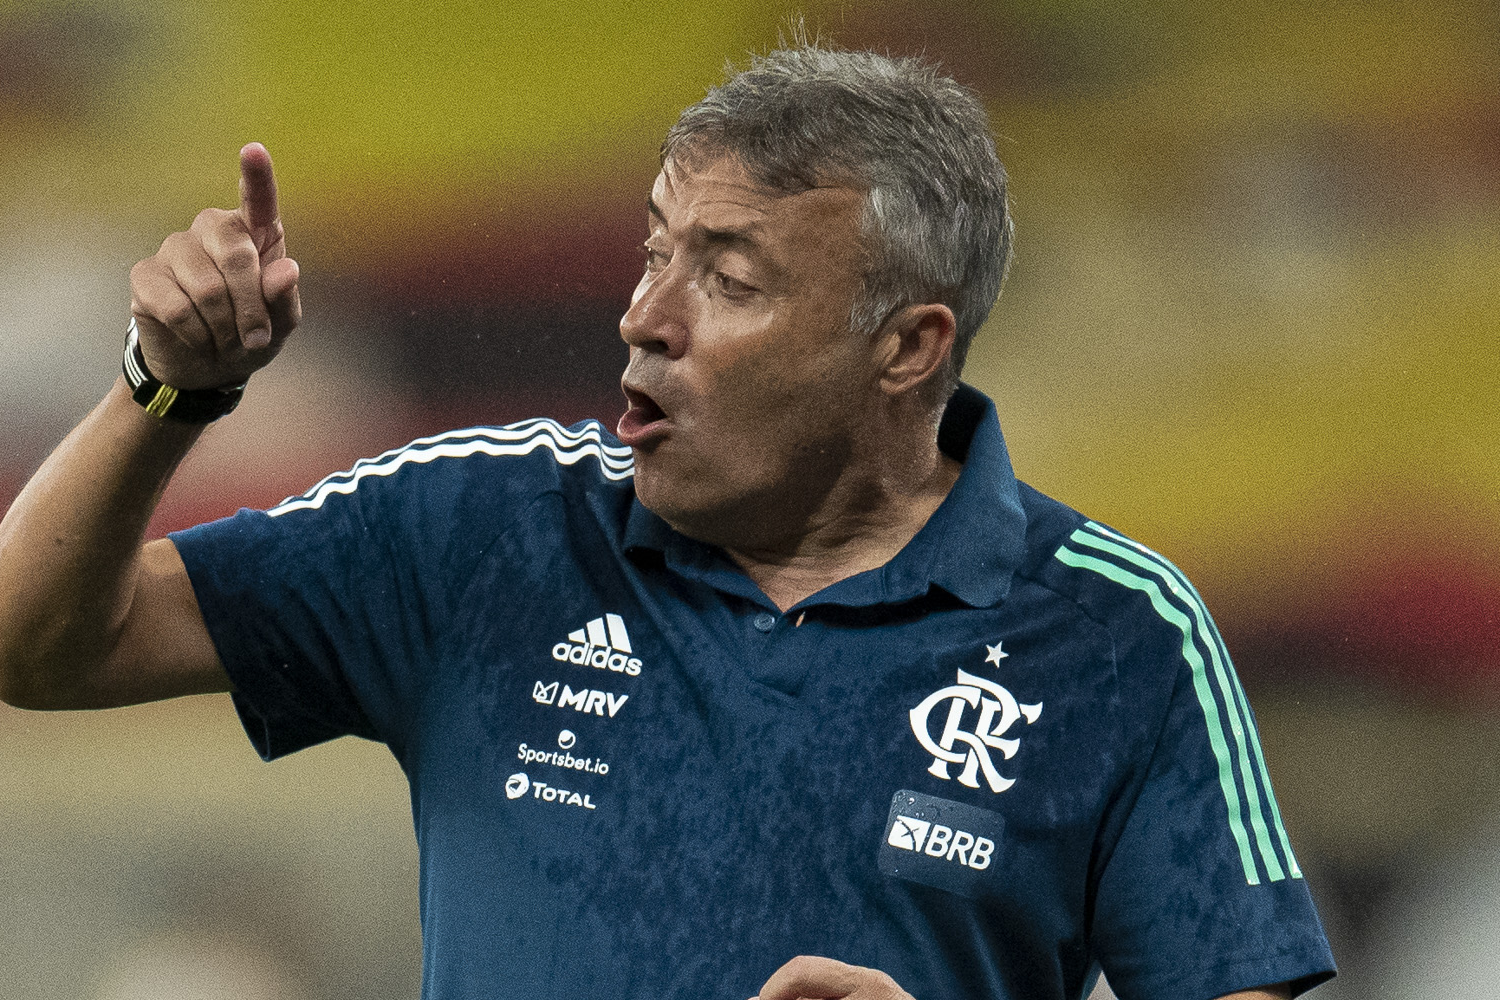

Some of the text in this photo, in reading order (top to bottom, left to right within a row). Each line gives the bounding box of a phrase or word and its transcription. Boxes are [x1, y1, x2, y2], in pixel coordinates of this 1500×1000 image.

[552, 642, 643, 676] adidas
[556, 682, 628, 717] MRV
[517, 743, 609, 775] Sportsbet.io
[924, 822, 994, 869] BRB
